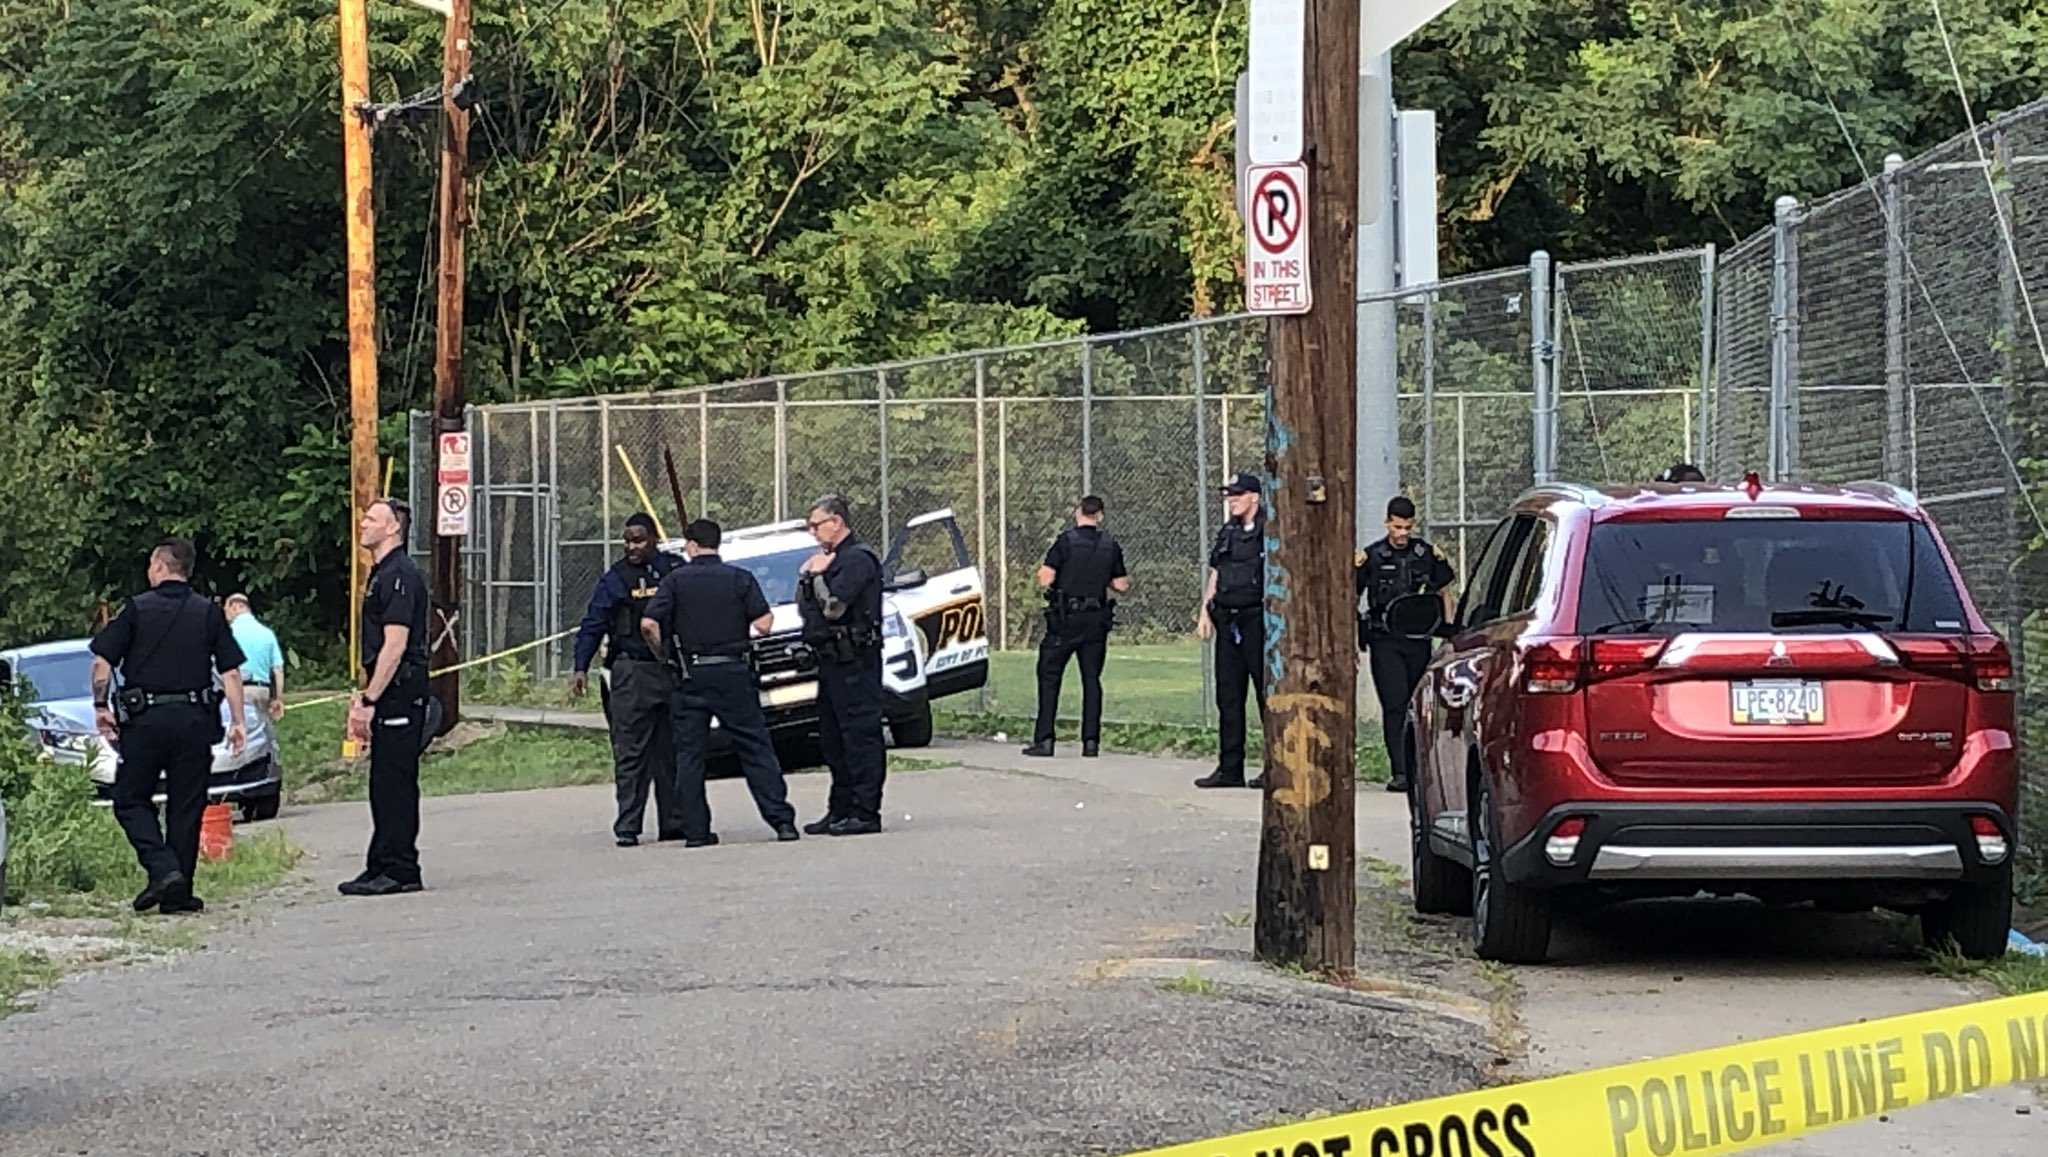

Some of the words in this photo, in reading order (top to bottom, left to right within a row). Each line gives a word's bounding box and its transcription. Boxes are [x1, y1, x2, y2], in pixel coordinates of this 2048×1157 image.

[1253, 261, 1266, 278] IN
[1271, 259, 1301, 278] THIS
[1253, 284, 1302, 304] STREET
[1606, 1059, 1786, 1157] POLICE
[1798, 1038, 1909, 1127] LINE
[1922, 1024, 1992, 1100] DO
